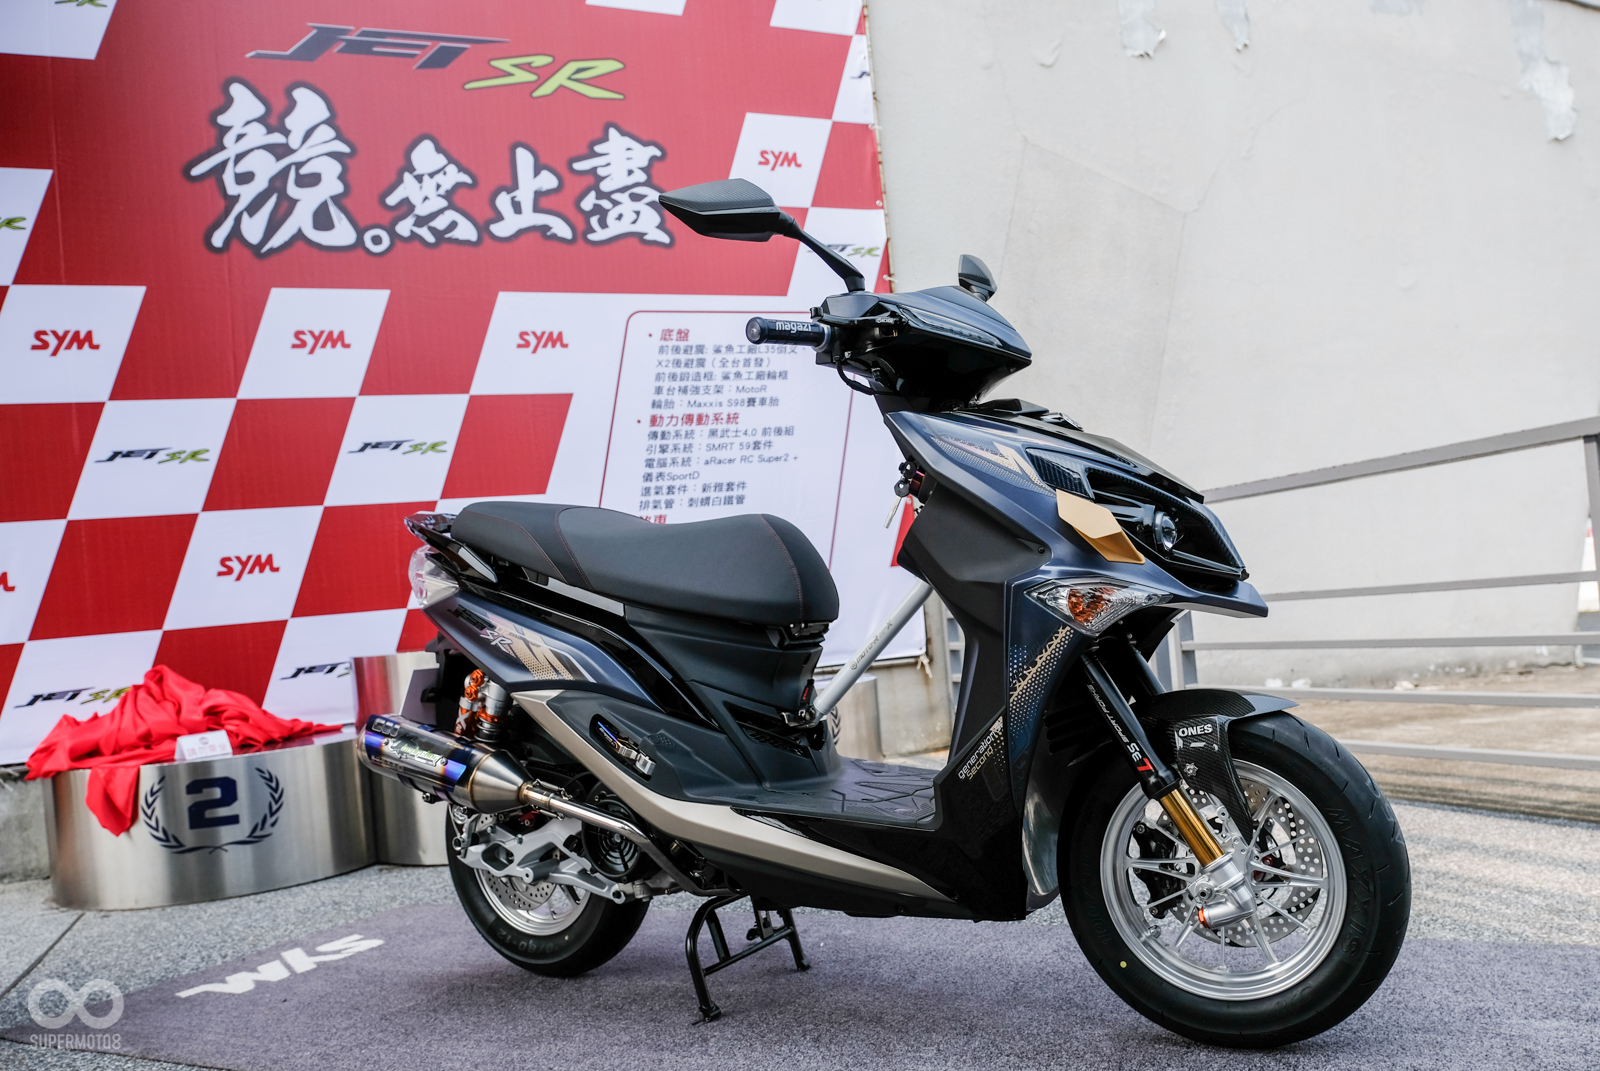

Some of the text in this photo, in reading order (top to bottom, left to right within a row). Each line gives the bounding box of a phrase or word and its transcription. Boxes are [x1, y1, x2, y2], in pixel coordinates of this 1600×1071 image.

[245, 23, 625, 100] JET SR
[758, 149, 802, 171] SYM
[659, 328, 690, 342] 底盤
[775, 321, 812, 333] magazi
[30, 329, 101, 357] SYM
[291, 329, 352, 356] SYM
[516, 330, 569, 355] SYM
[649, 412, 740, 428] 動力傳動系統
[94, 446, 172, 464] JET
[347, 438, 415, 454] JET
[740, 455, 753, 464] RC
[216, 553, 280, 581] SYM
[14, 686, 95, 709] JET
[1106, 713, 1131, 743] SPORT
[957, 729, 996, 780] generation
[185, 776, 240, 830] 2
